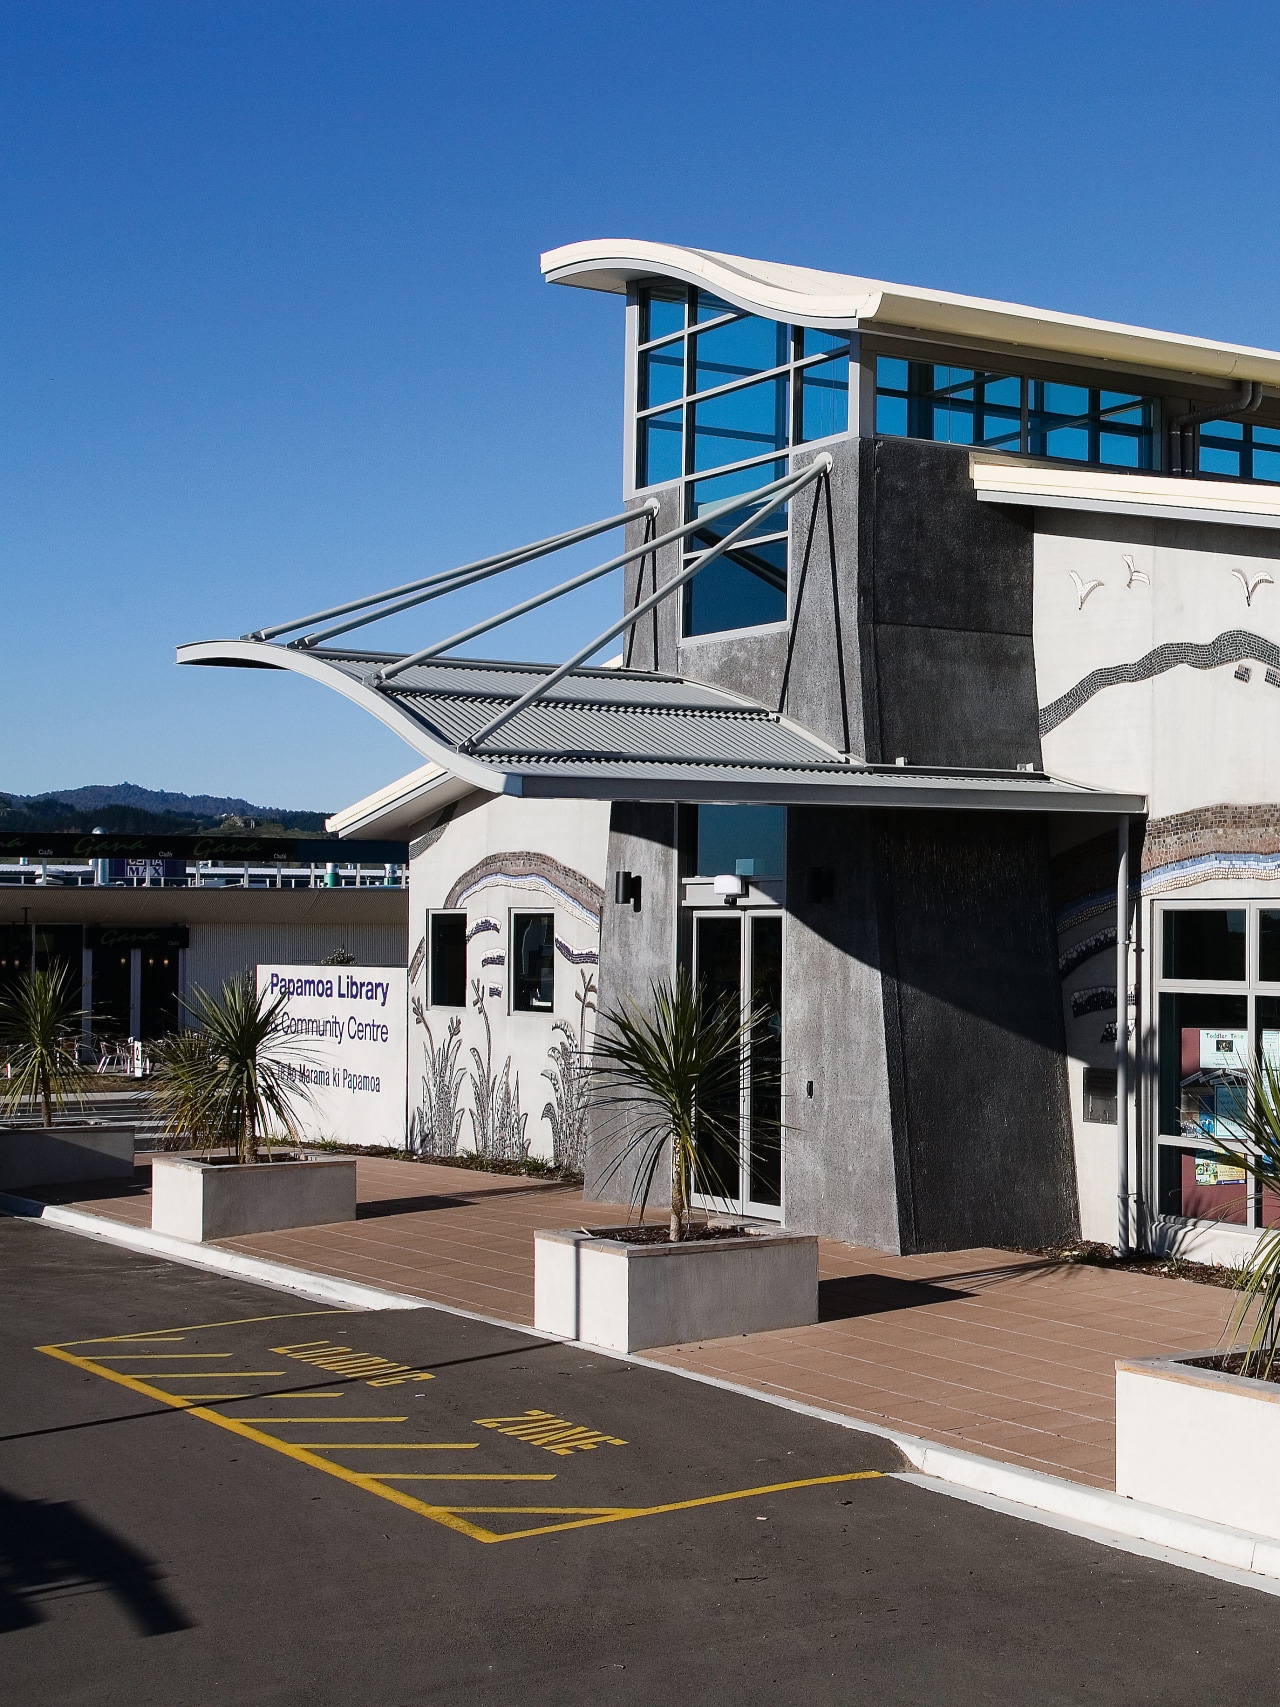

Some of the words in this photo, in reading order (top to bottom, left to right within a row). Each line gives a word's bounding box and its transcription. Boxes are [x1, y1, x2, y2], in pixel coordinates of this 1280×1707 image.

[270, 972, 333, 1001] Papamoa
[337, 974, 390, 1007] Library
[281, 1011, 345, 1045] Community
[347, 1015, 389, 1043] Centre
[1205, 1032, 1227, 1040] Toddler
[332, 1067, 340, 1088] ki
[342, 1068, 381, 1094] Papamoa
[268, 1340, 436, 1388] LOADING
[472, 1409, 629, 1456] ZONE
